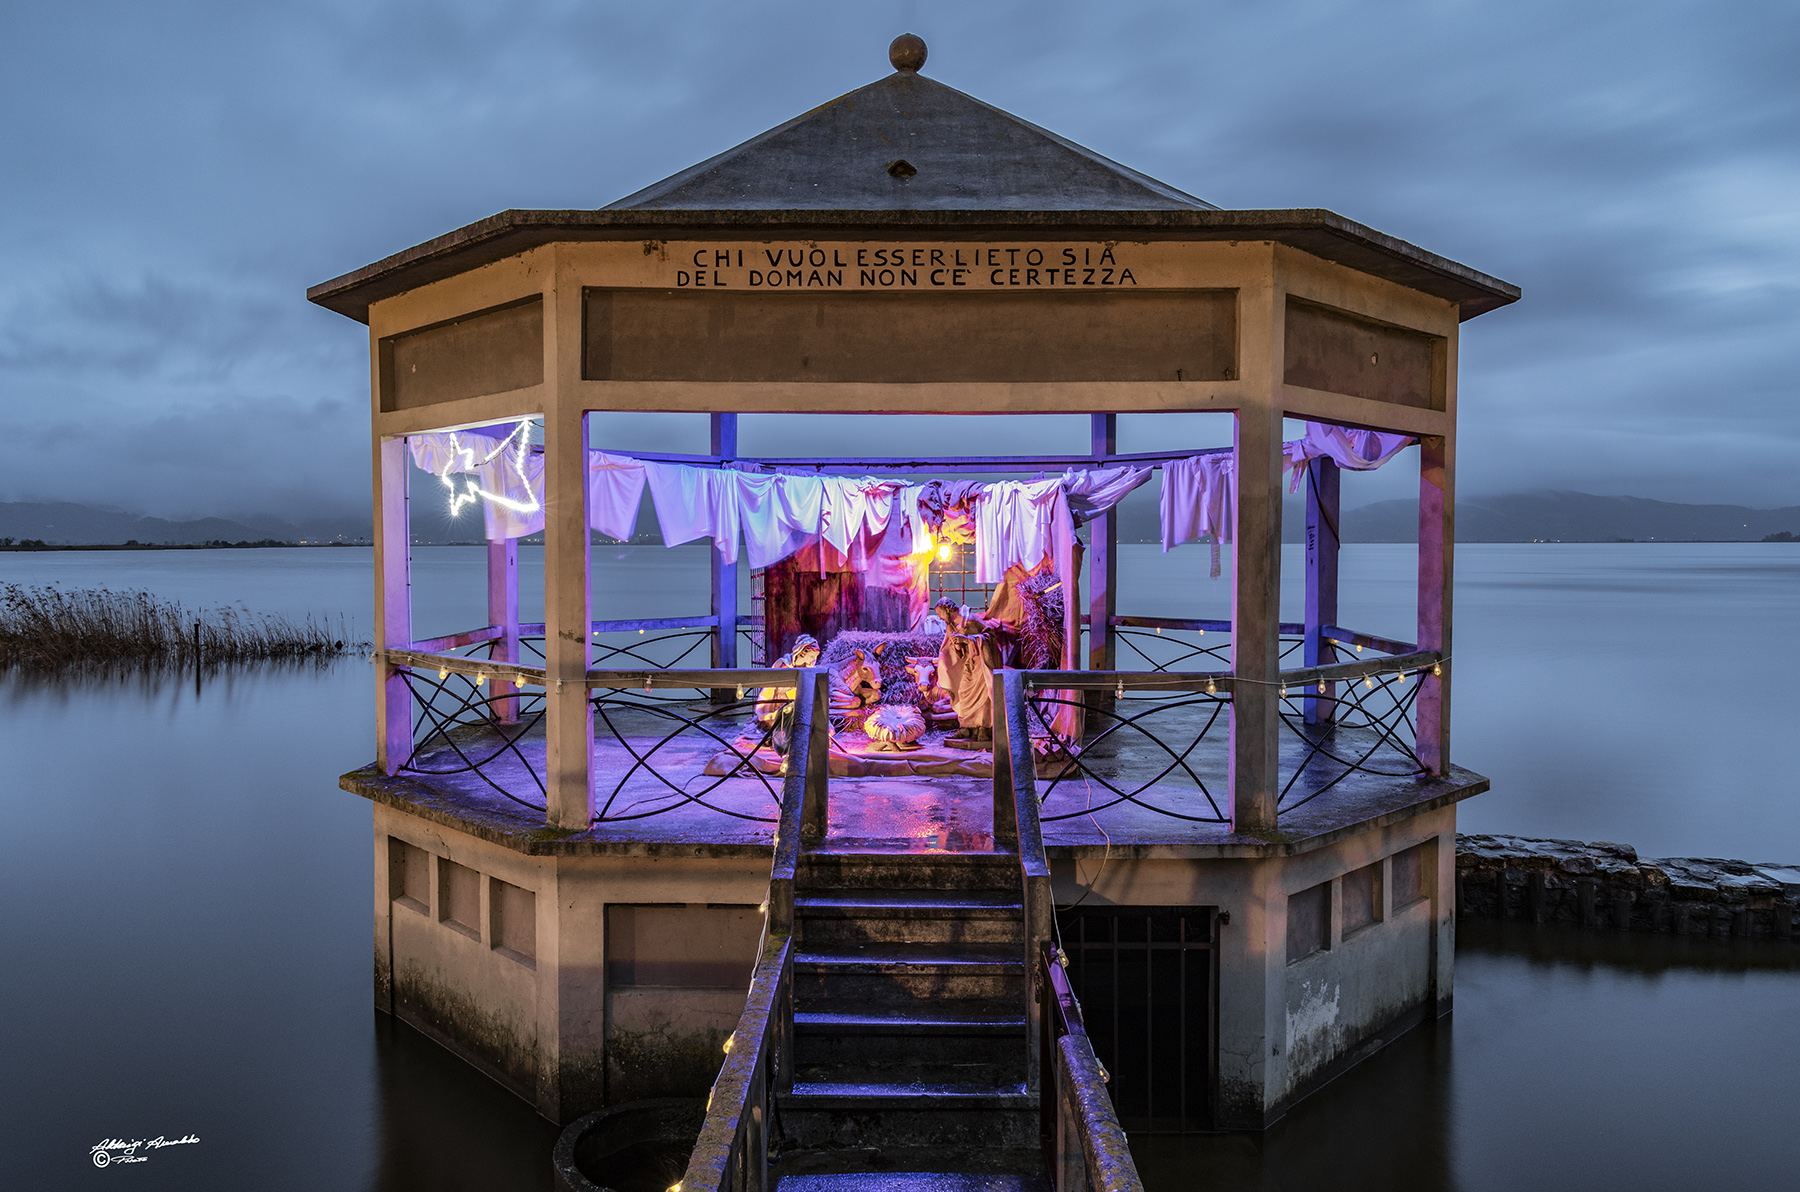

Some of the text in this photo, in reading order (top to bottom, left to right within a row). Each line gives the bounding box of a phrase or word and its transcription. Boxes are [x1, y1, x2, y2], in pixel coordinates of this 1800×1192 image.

[693, 247, 1117, 268] CHI VUOL ESSER LIETO SIA
[677, 270, 727, 287] DEL
[749, 269, 842, 287] DOMAN
[860, 268, 917, 287] NON
[990, 267, 1137, 286] CERTEZZA
